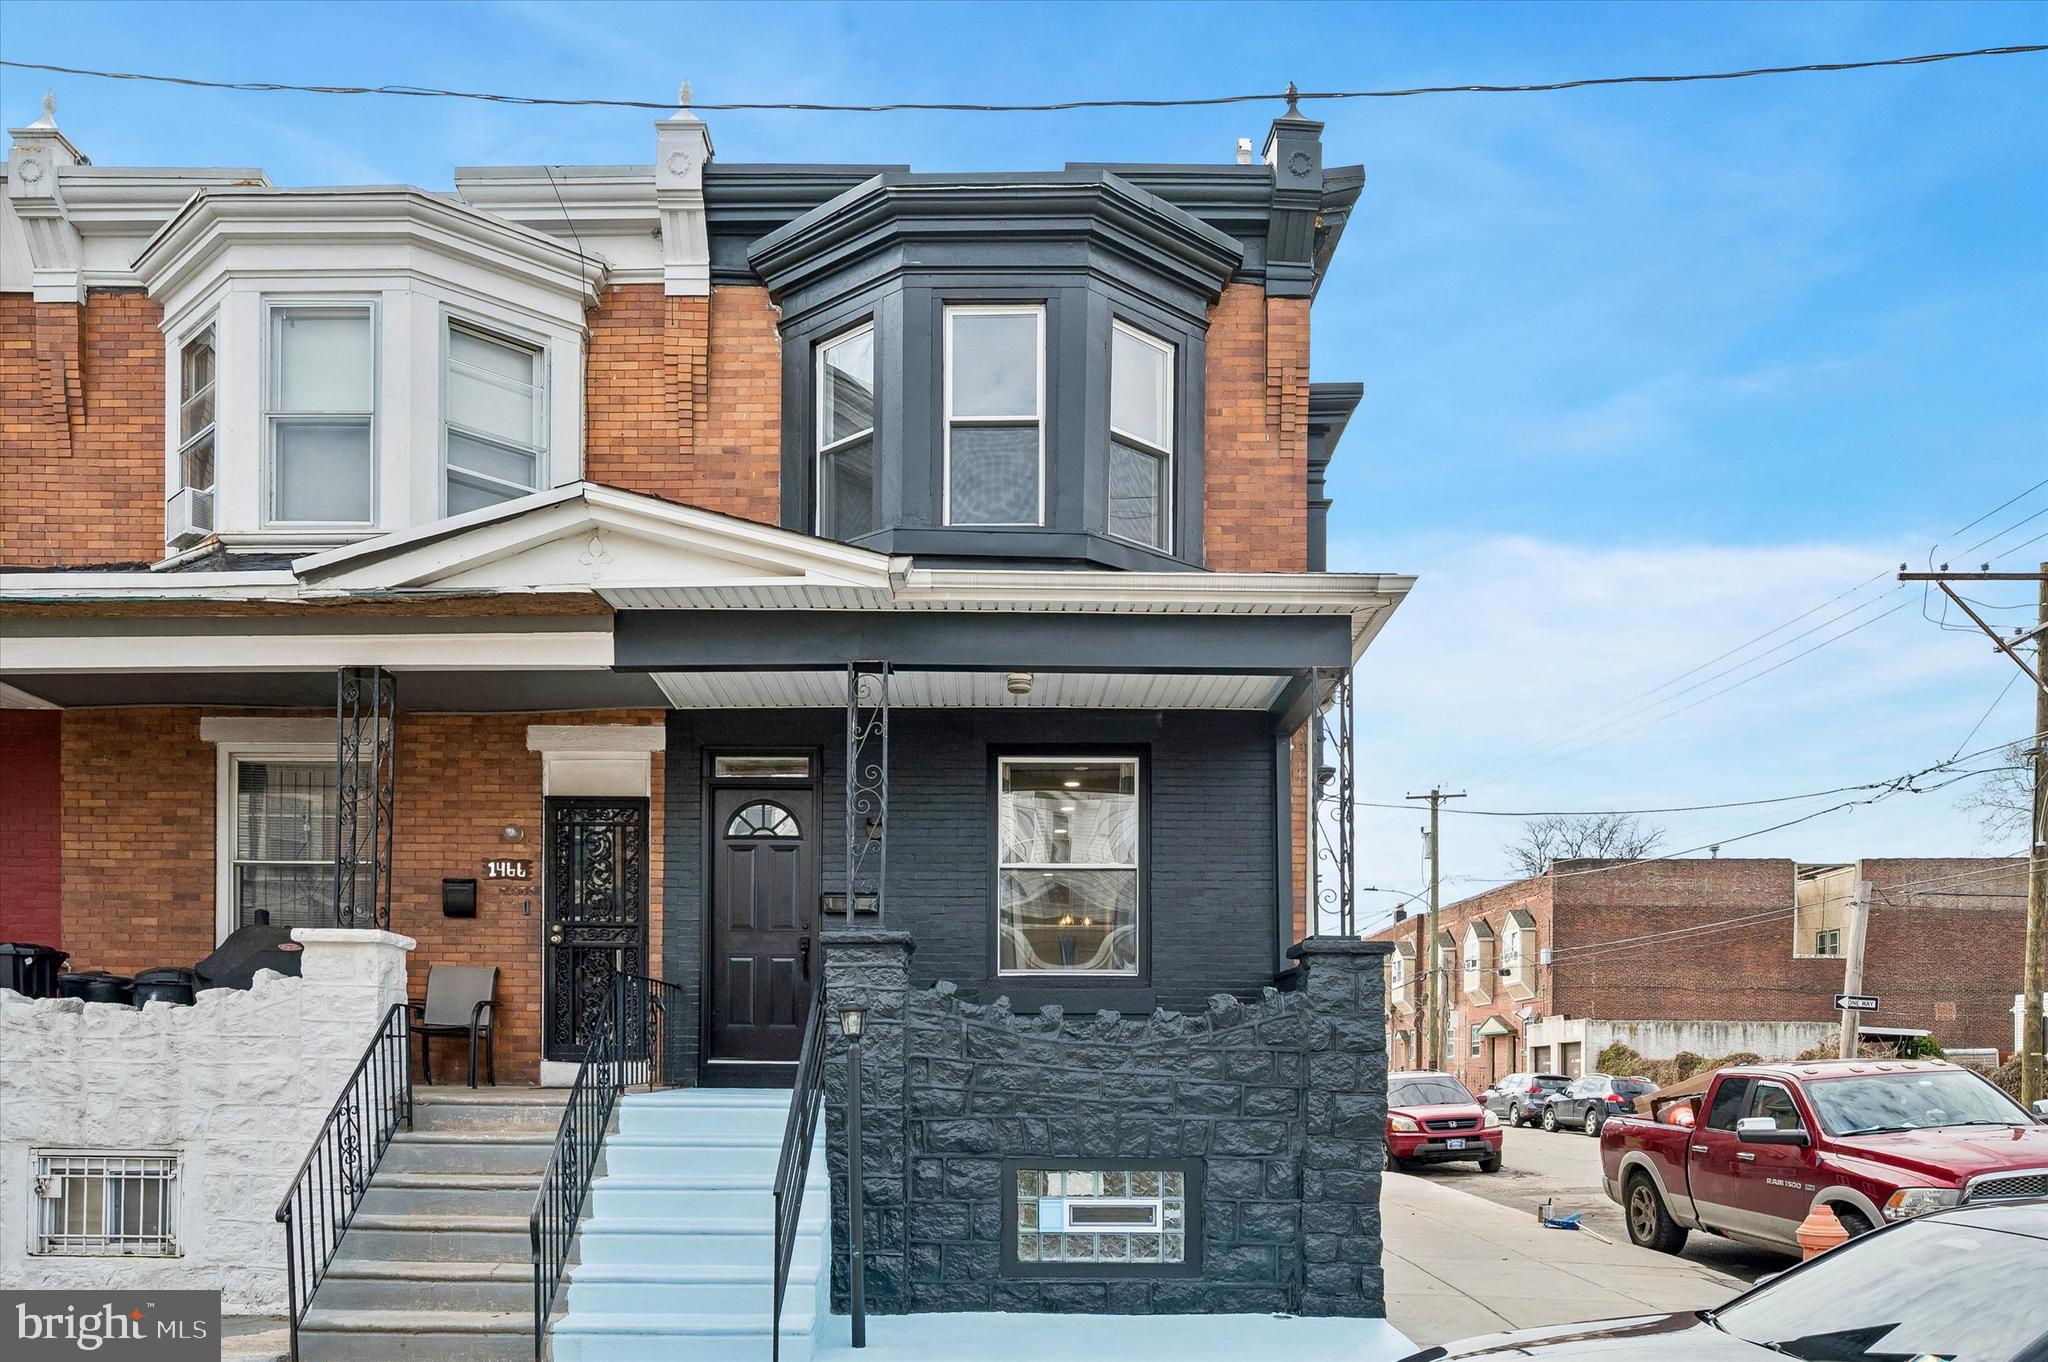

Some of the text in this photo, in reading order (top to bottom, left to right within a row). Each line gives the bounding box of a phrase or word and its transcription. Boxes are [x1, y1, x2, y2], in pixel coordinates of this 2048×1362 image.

[488, 861, 526, 878] 1466
[1847, 999, 1875, 1008] ONE WAY
[1766, 1177, 1784, 1187] RAM
[1785, 1180, 1802, 1190] 1500
